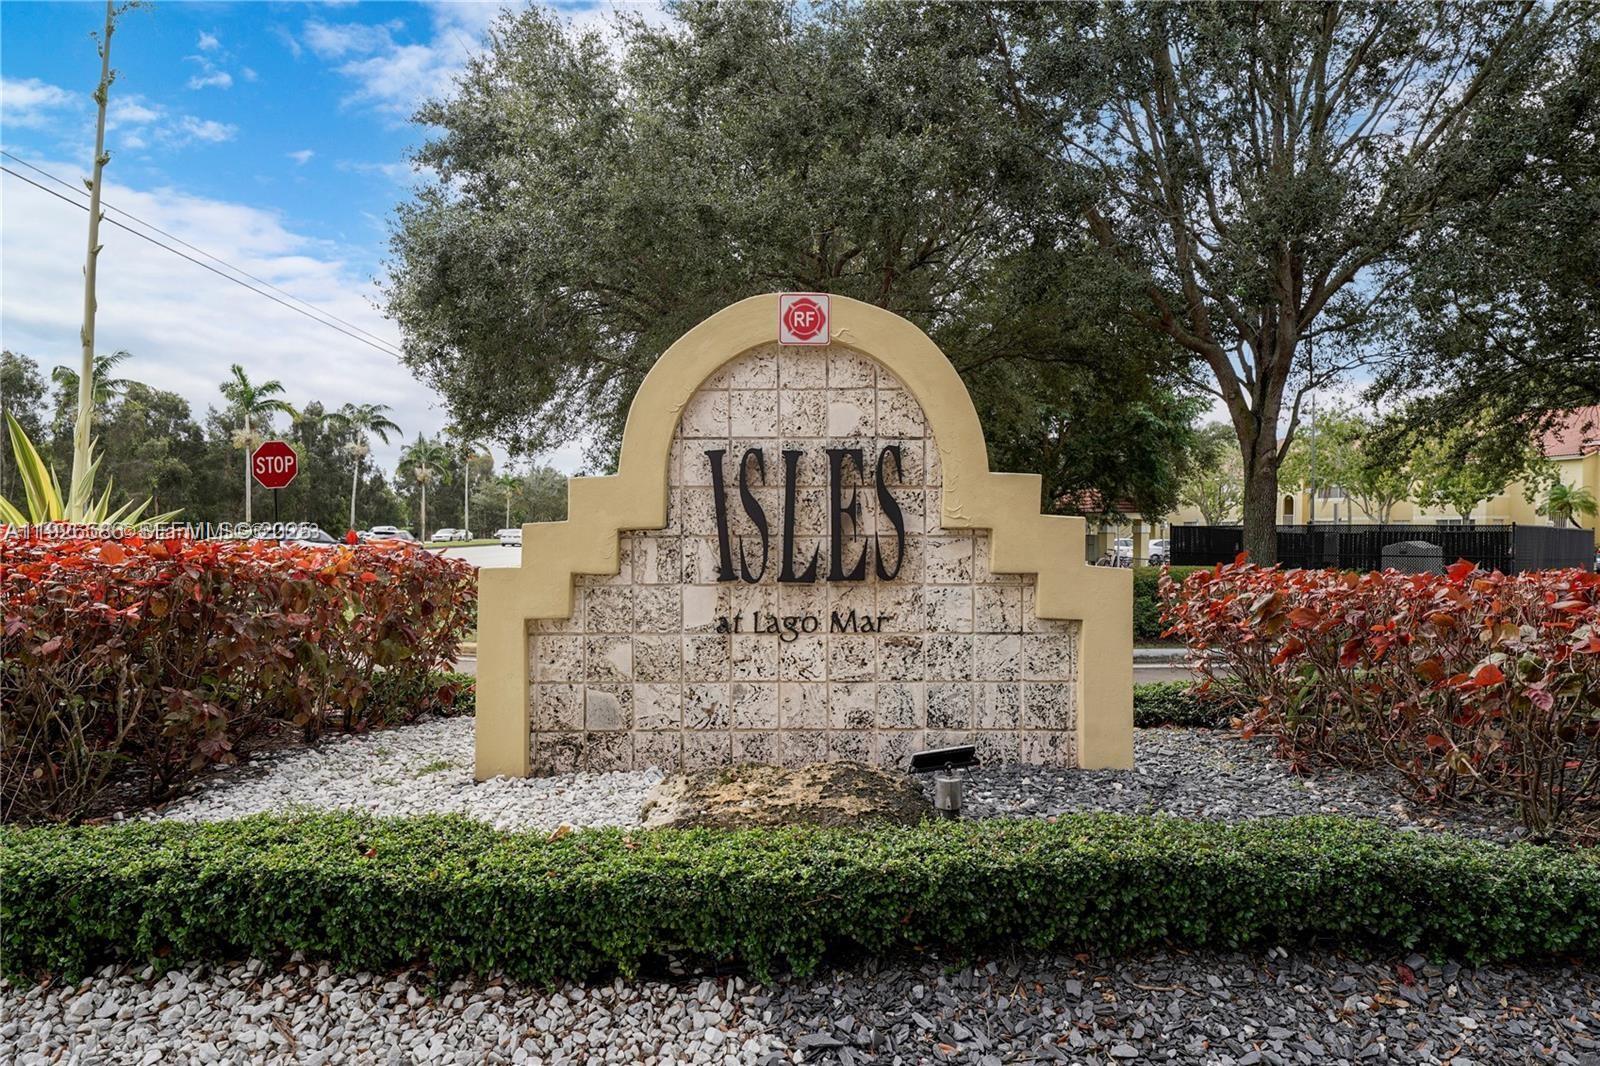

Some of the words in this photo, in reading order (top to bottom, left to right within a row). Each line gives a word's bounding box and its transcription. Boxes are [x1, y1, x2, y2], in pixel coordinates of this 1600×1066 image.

[794, 311, 815, 327] RF
[256, 456, 294, 474] STOP
[704, 447, 905, 584] ISLES
[716, 612, 744, 633] at
[753, 611, 818, 642] Lago
[830, 611, 890, 633] Mar
